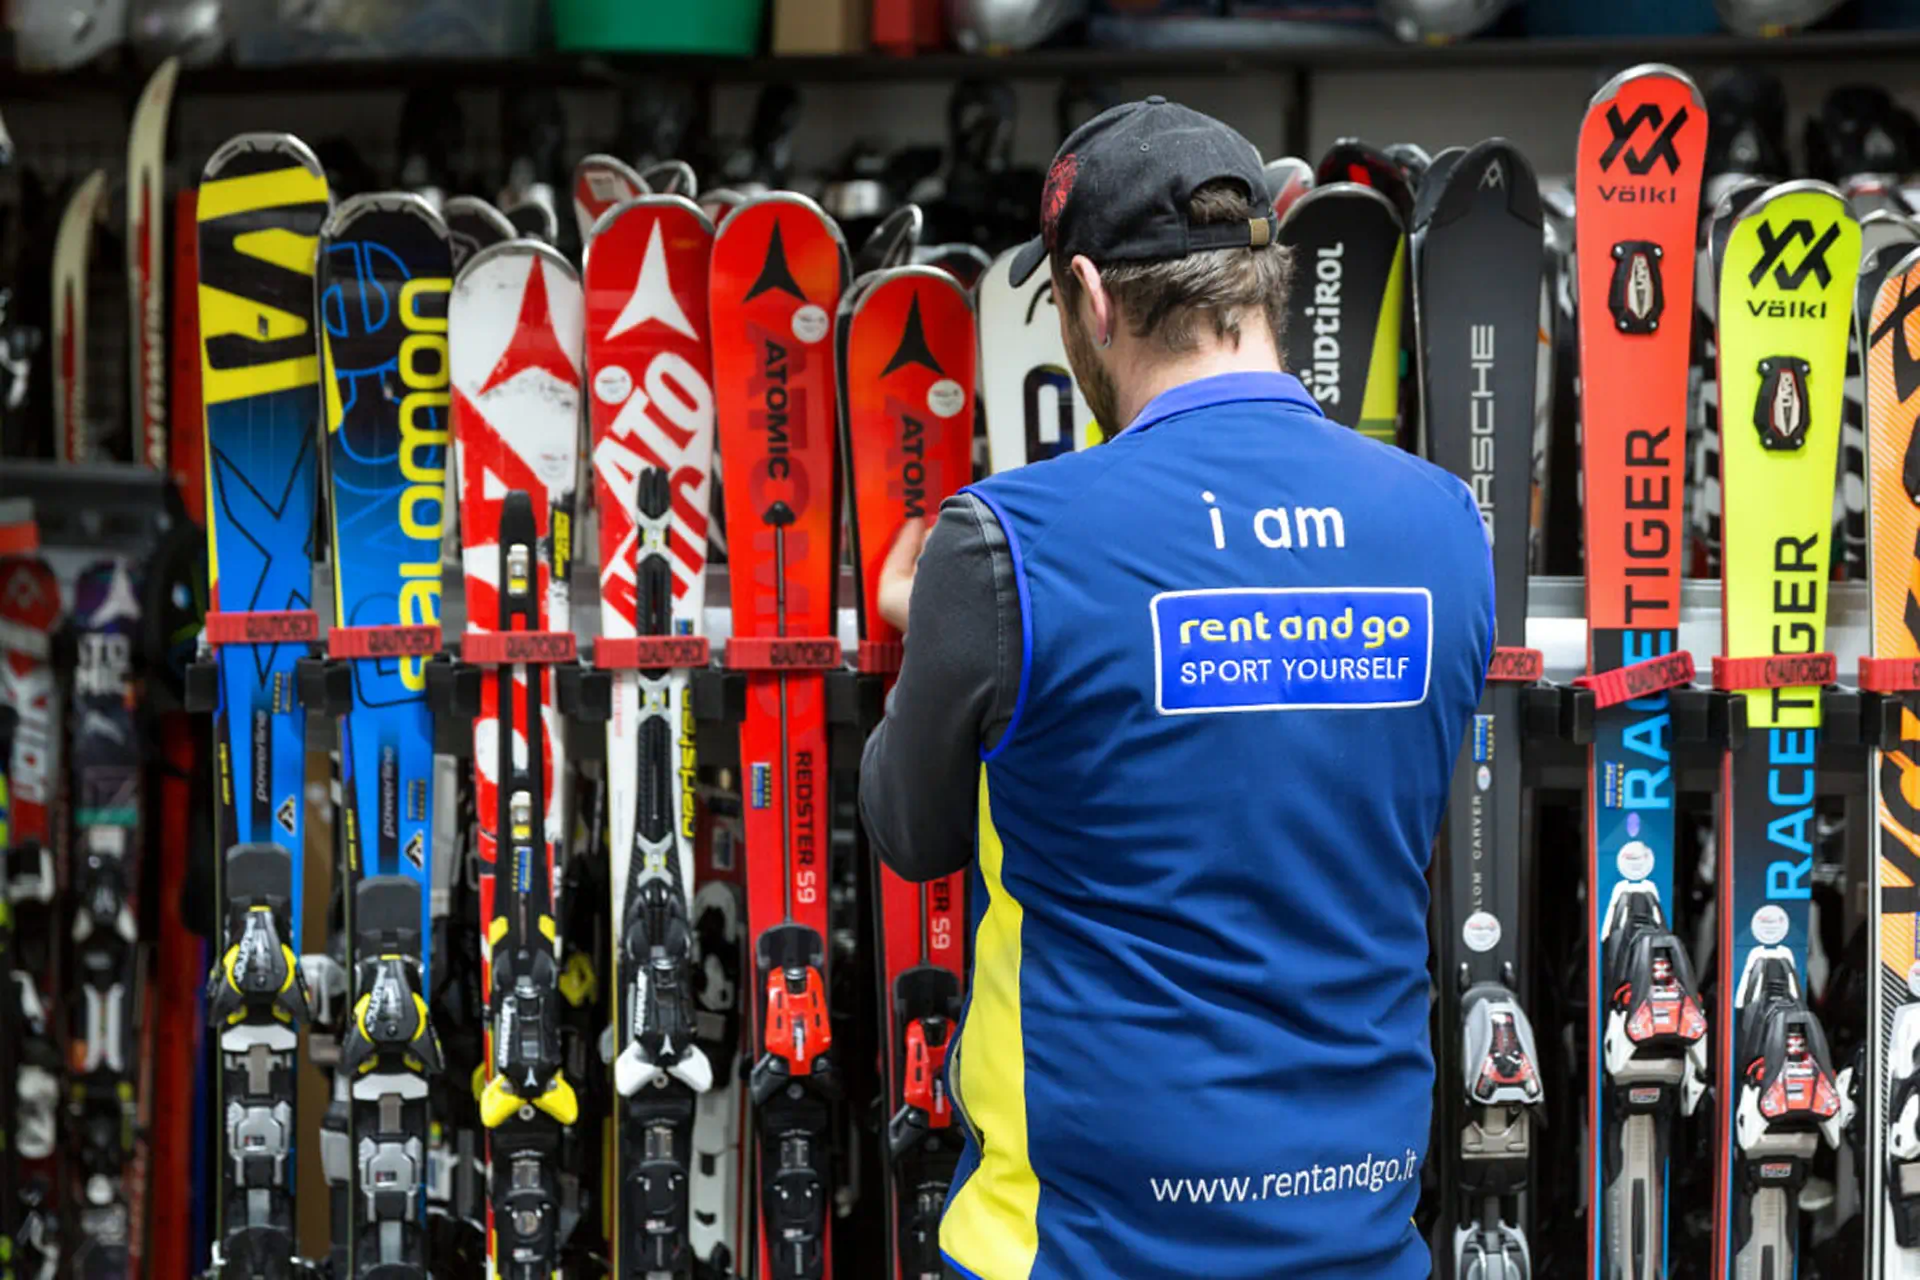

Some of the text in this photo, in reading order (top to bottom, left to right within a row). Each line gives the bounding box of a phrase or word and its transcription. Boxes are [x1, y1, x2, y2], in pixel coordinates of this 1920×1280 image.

[1598, 185, 1677, 204] Völkl
[1747, 300, 1827, 319] Völkl
[764, 339, 790, 481] ATOMIC
[1471, 325, 1495, 547] RSCHE
[902, 414, 925, 519] ATOM
[1202, 490, 1345, 549] i am
[1180, 607, 1410, 649] rent and go
[1180, 657, 1410, 684] SPORT YOURSELF
[1766, 532, 1819, 900] RACETGER
[255, 708, 268, 803] powerline
[382, 745, 395, 838] powerline
[795, 751, 815, 904] REDSTER S9
[1472, 795, 1483, 860] CARVER
[931, 917, 951, 950] S9
[1150, 1148, 1418, 1203] www.rentandgo.it
